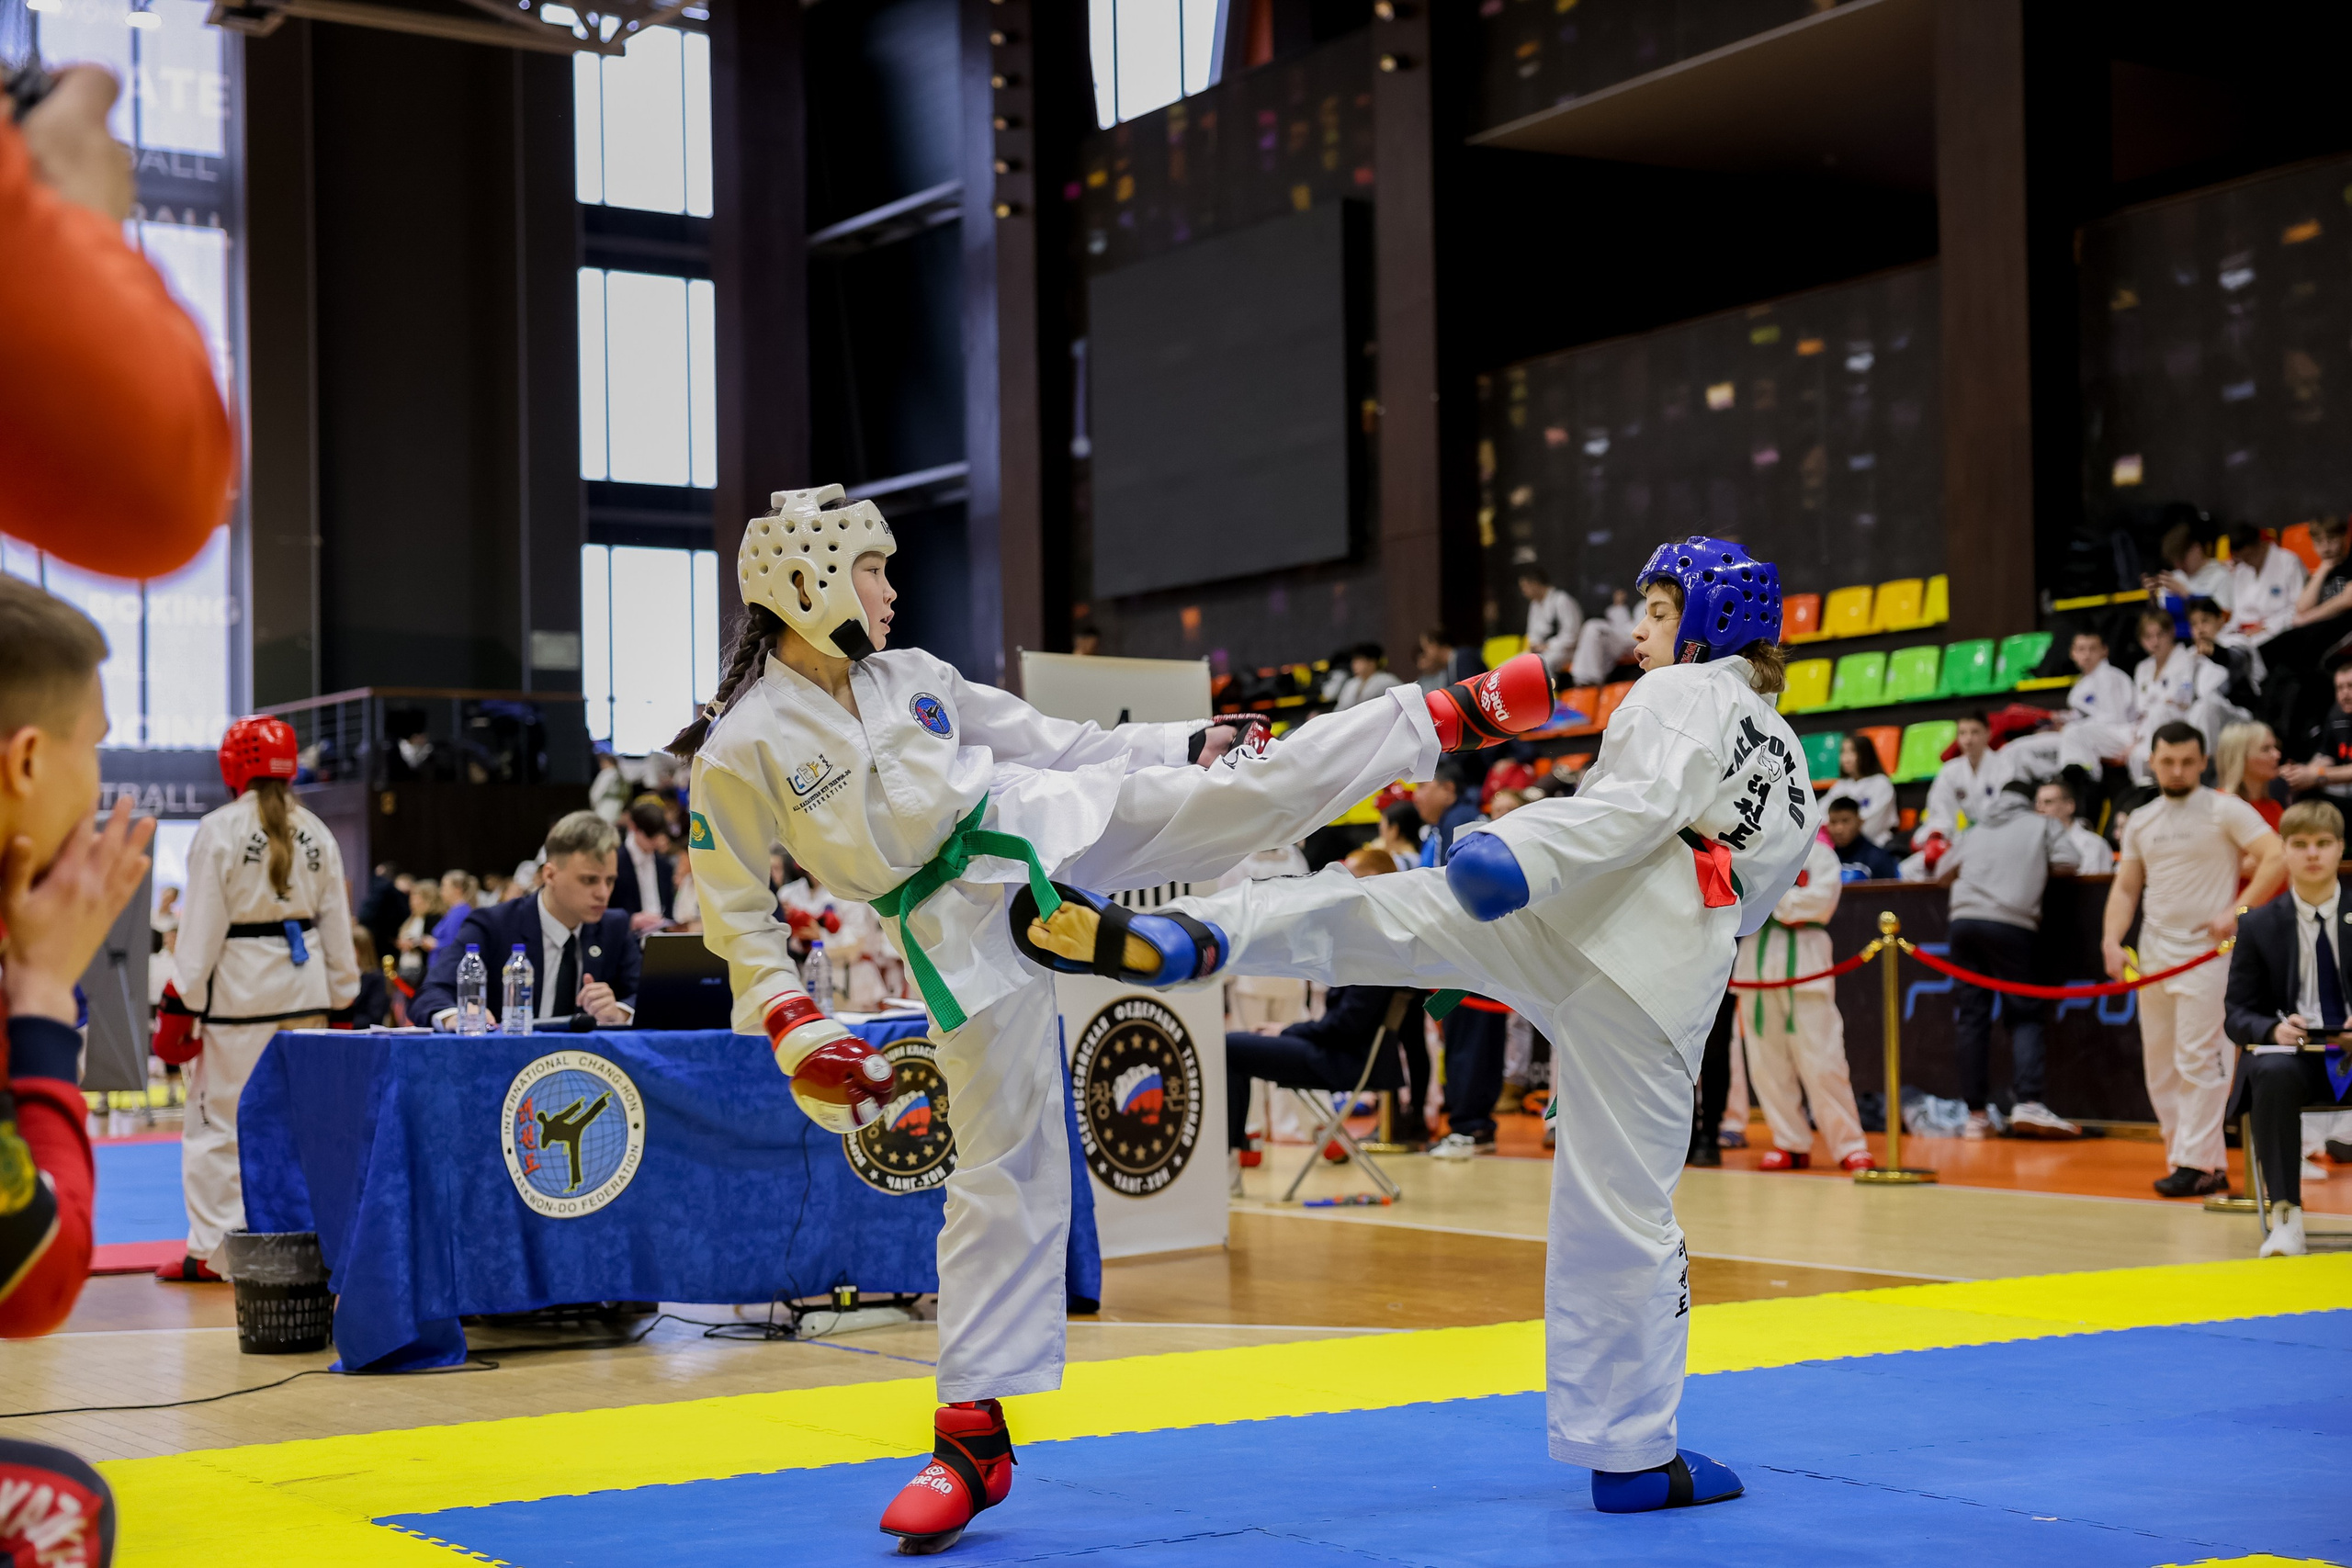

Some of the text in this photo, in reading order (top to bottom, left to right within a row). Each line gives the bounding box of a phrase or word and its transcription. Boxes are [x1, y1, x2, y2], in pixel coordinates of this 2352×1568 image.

[99, 782, 207, 814] TBALL
[1723, 716, 1805, 830] TAEKON-DO
[504, 1056, 639, 1134] INTERNATIONAL CHANG-HON
[1072, 1000, 1201, 1156] ВСЕРОССИЙСКАЯ ФЕДЕРАЦИЯ ТХЭКВОНДО
[513, 1143, 639, 1213] TAEKWON-DO FEDERATION
[885, 1165, 947, 1190] ЧАНГ-ХОН
[1113, 1167, 1171, 1194] ЧАНГ-ХОН
[910, 1474, 933, 1485] ae
